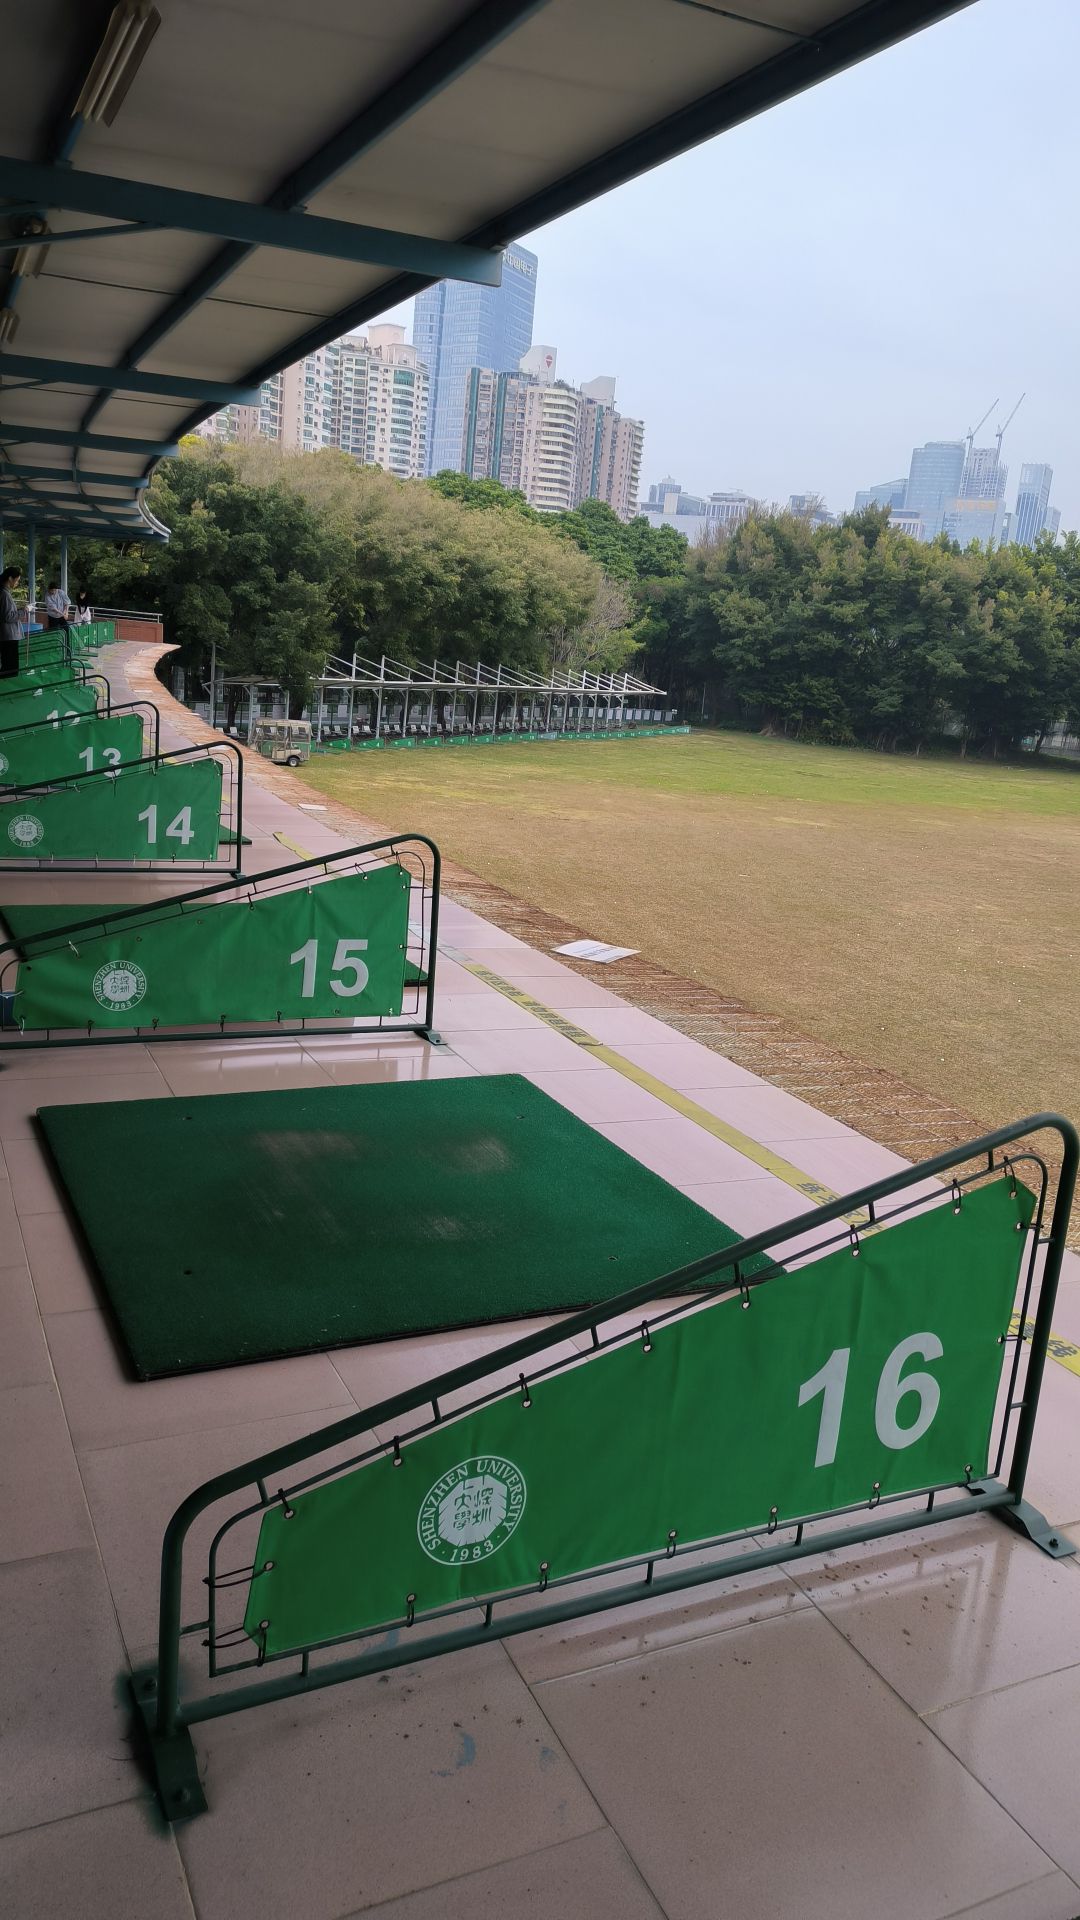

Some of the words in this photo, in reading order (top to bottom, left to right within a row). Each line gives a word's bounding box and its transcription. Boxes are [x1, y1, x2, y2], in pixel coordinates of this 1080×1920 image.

[79, 746, 122, 778] 13
[138, 804, 194, 845] 14
[94, 962, 117, 1001] SHENZHEN
[119, 962, 145, 1000] UNIVERSITY
[290, 939, 369, 998] 15
[109, 1000, 132, 1010] 1983
[797, 1331, 944, 1468] 16
[421, 1465, 469, 1551] SHENZHEN
[476, 1459, 523, 1531] UNIVERSITY
[449, 1540, 494, 1562] 1983
